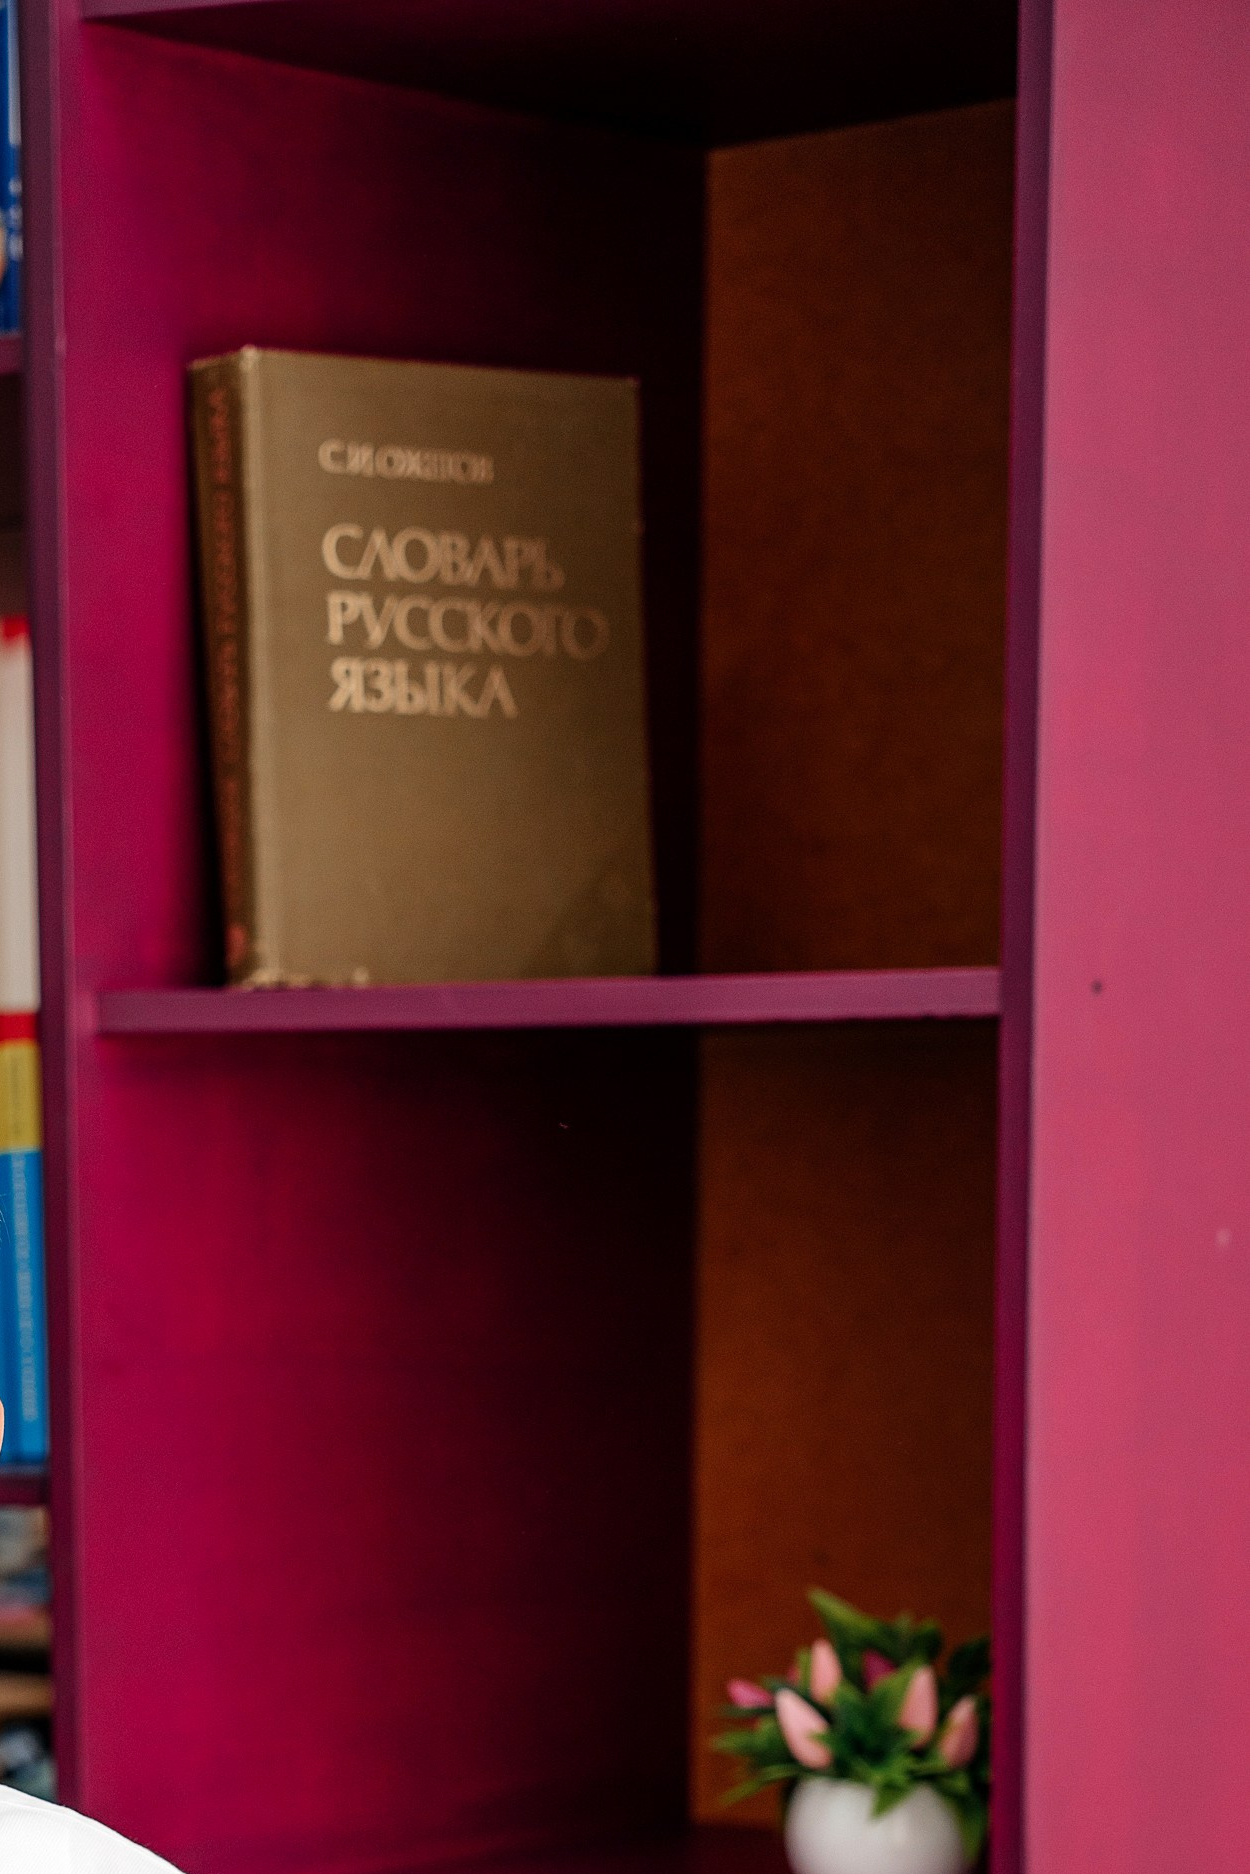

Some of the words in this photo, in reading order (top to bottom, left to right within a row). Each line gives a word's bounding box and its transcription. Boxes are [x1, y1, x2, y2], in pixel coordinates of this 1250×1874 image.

[321, 523, 565, 591] СЛОВАРЬ
[325, 591, 611, 660] РУССКОГО
[328, 656, 519, 719] ЯЗЫКА
